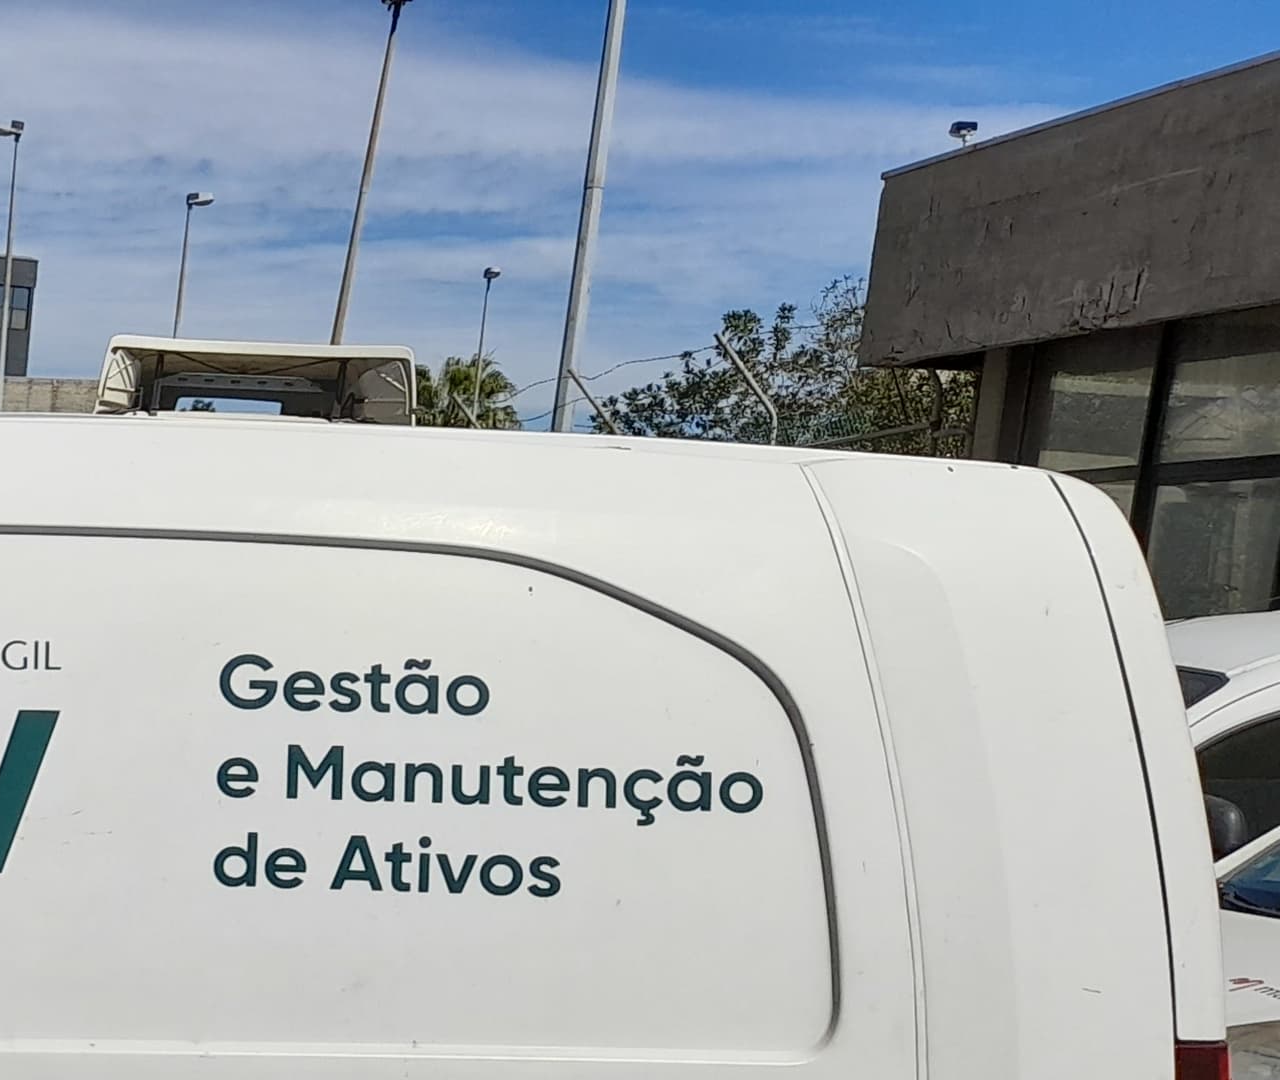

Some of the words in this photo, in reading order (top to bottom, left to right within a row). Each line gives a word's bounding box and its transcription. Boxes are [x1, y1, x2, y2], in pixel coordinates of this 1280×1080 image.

[218, 653, 490, 717] Gestão
[217, 756, 259, 799] e
[286, 744, 764, 827] Manutenção
[213, 832, 307, 889] de
[329, 834, 562, 898] Ativos
